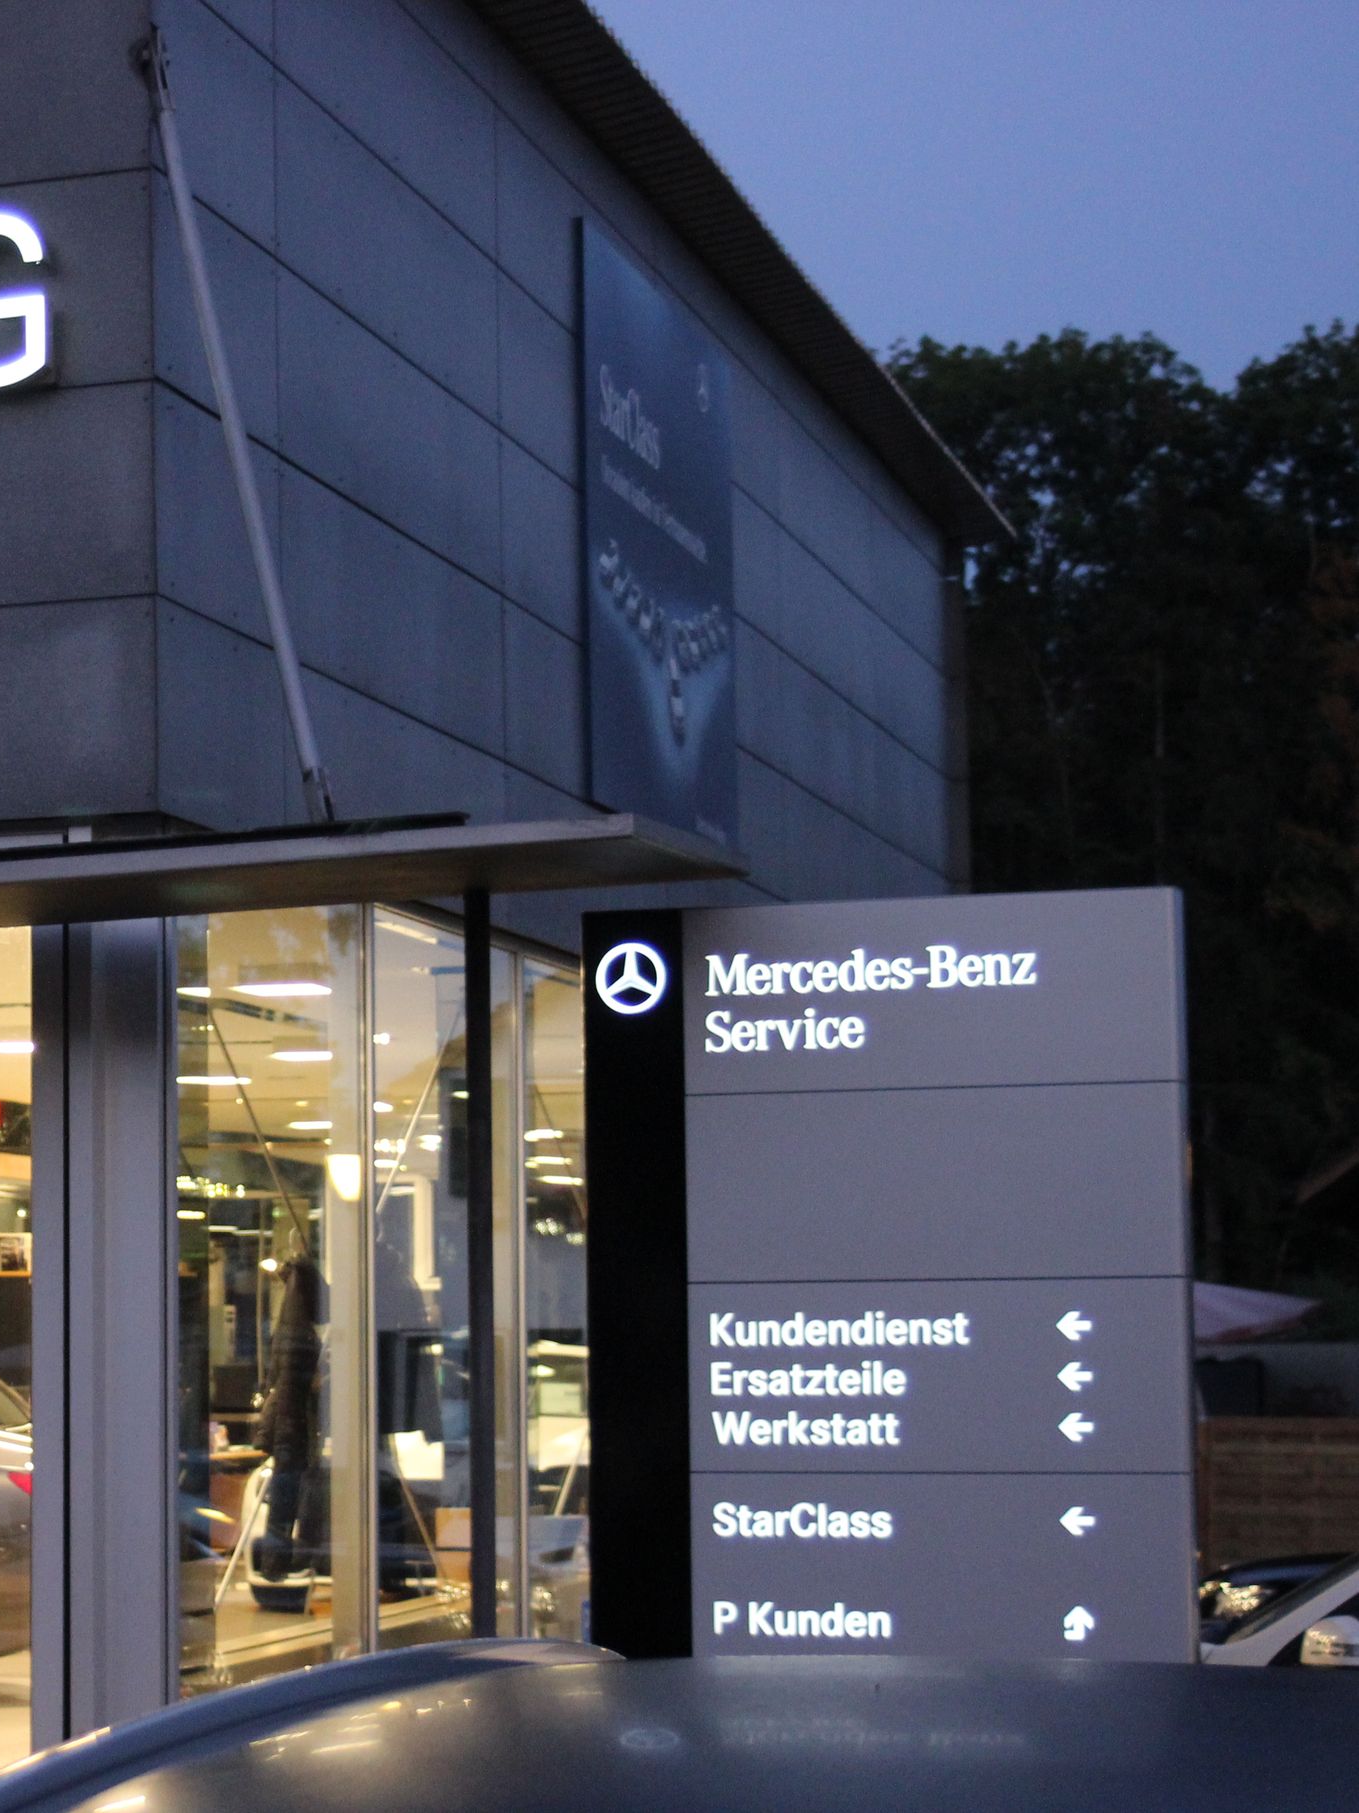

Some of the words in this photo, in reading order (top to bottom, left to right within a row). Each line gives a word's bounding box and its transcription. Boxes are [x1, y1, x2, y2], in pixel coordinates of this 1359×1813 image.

[704, 944, 1038, 998] Mercedes-Benz
[704, 1007, 866, 1054] Service
[708, 1309, 971, 1348] Kundendienst
[709, 1359, 908, 1398] Ersatzteile
[711, 1409, 901, 1447] Werkstatt
[711, 1500, 894, 1540] StarClass
[713, 1600, 739, 1636] P
[747, 1600, 893, 1640] Kunden
